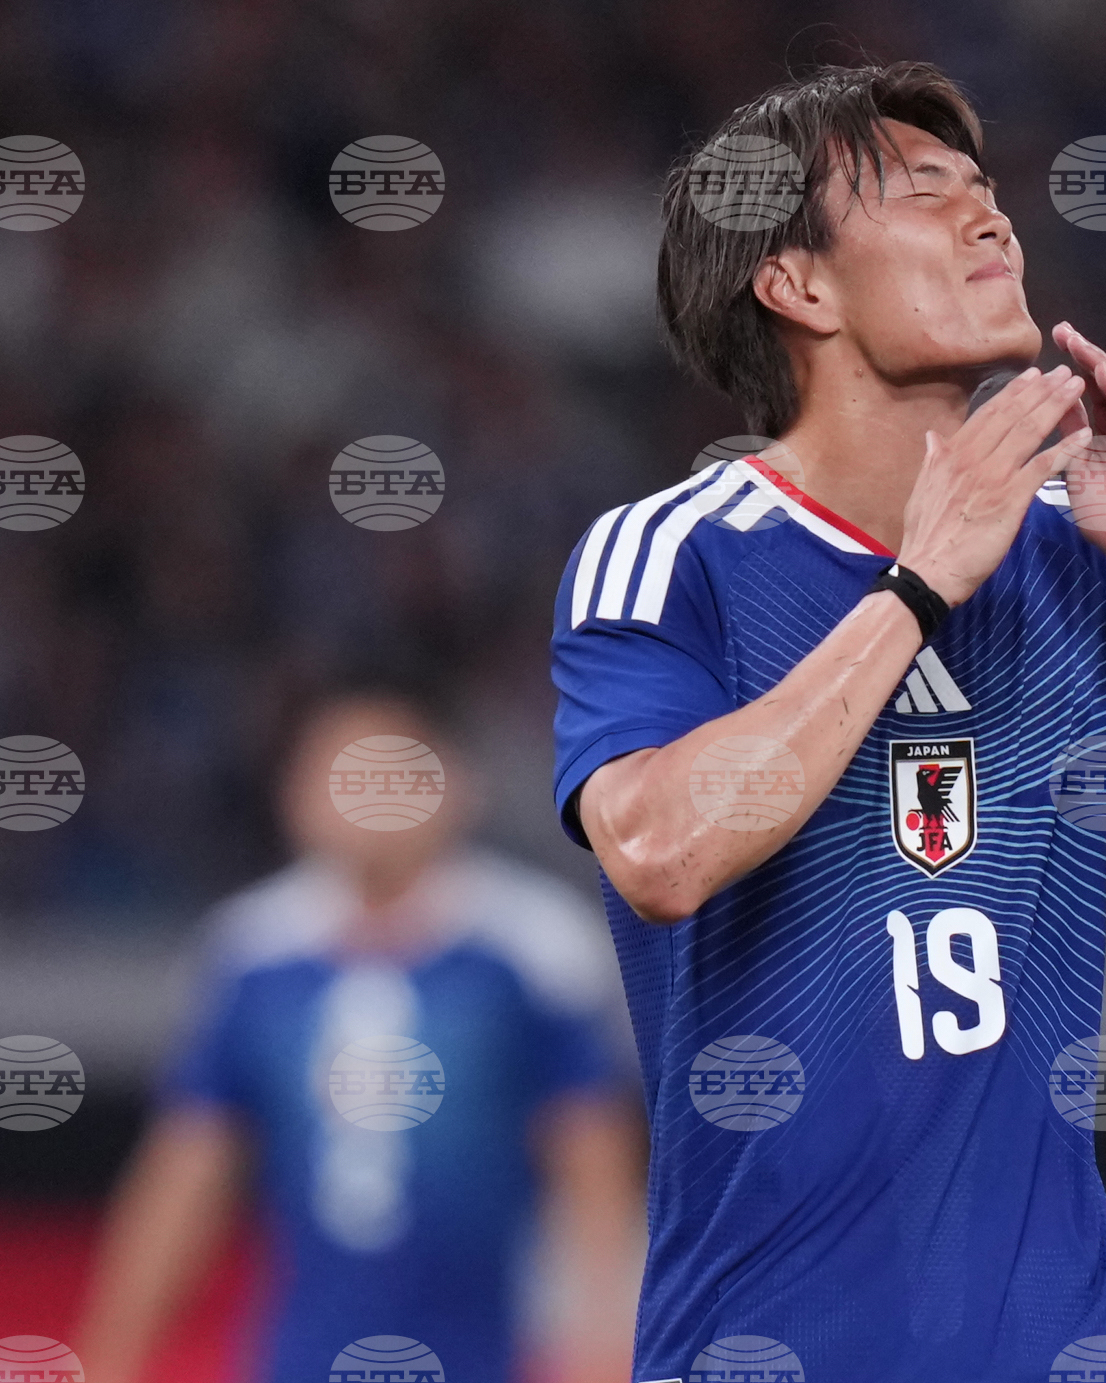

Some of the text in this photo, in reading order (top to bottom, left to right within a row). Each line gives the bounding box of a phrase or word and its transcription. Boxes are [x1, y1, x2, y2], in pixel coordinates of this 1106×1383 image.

[907, 745, 950, 757] JAPAN
[916, 831, 953, 852] JFA
[886, 907, 1006, 1060] 19
